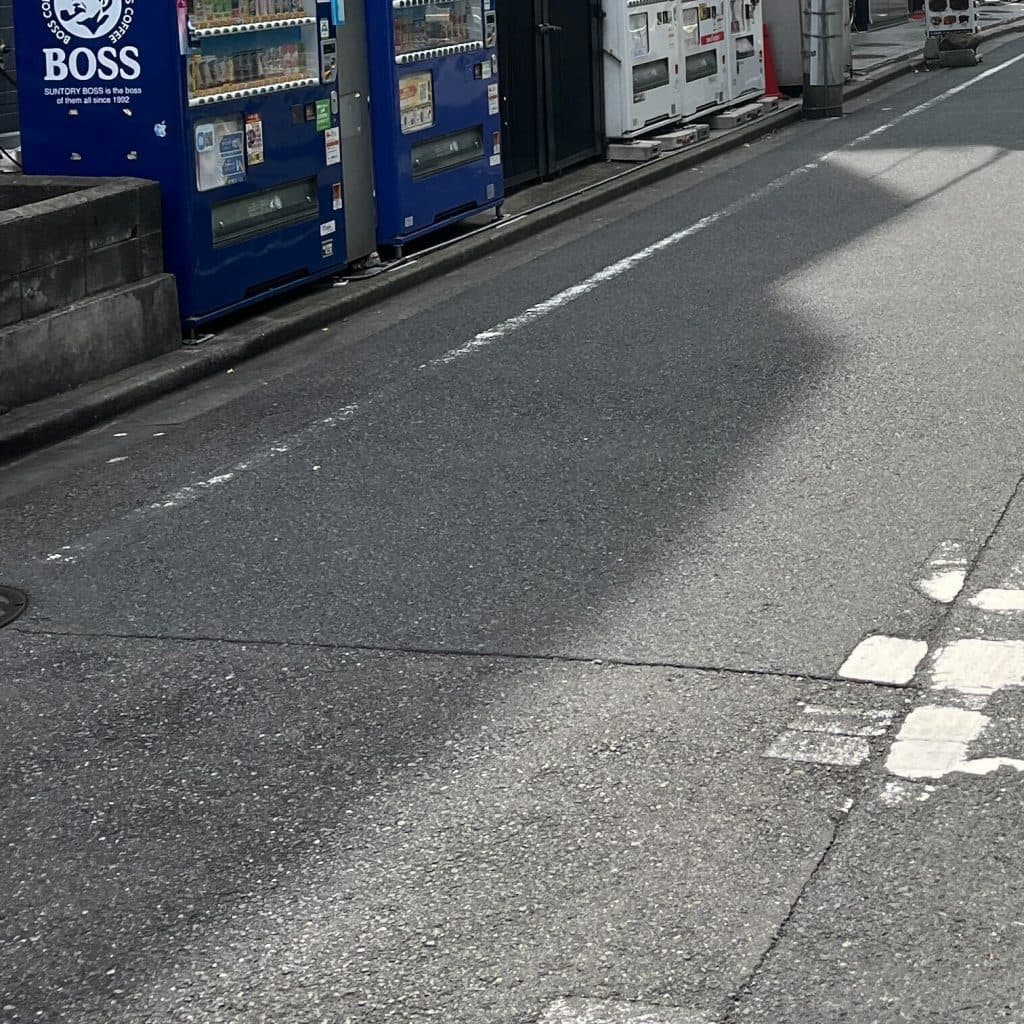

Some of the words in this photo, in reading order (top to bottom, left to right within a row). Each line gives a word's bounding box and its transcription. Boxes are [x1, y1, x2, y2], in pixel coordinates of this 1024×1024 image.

[47, 19, 71, 45] BOSS
[108, 7, 134, 44] COFFEE
[42, 45, 141, 81] BOSS
[43, 87, 82, 96] SUNTORY
[82, 86, 104, 95] BOSS
[104, 86, 112, 95] is
[112, 86, 124, 95] the
[124, 85, 142, 95] boss
[56, 96, 64, 105] of
[64, 96, 83, 104] them
[83, 96, 92, 104] all
[92, 95, 111, 104] since
[112, 95, 130, 104] 1992
